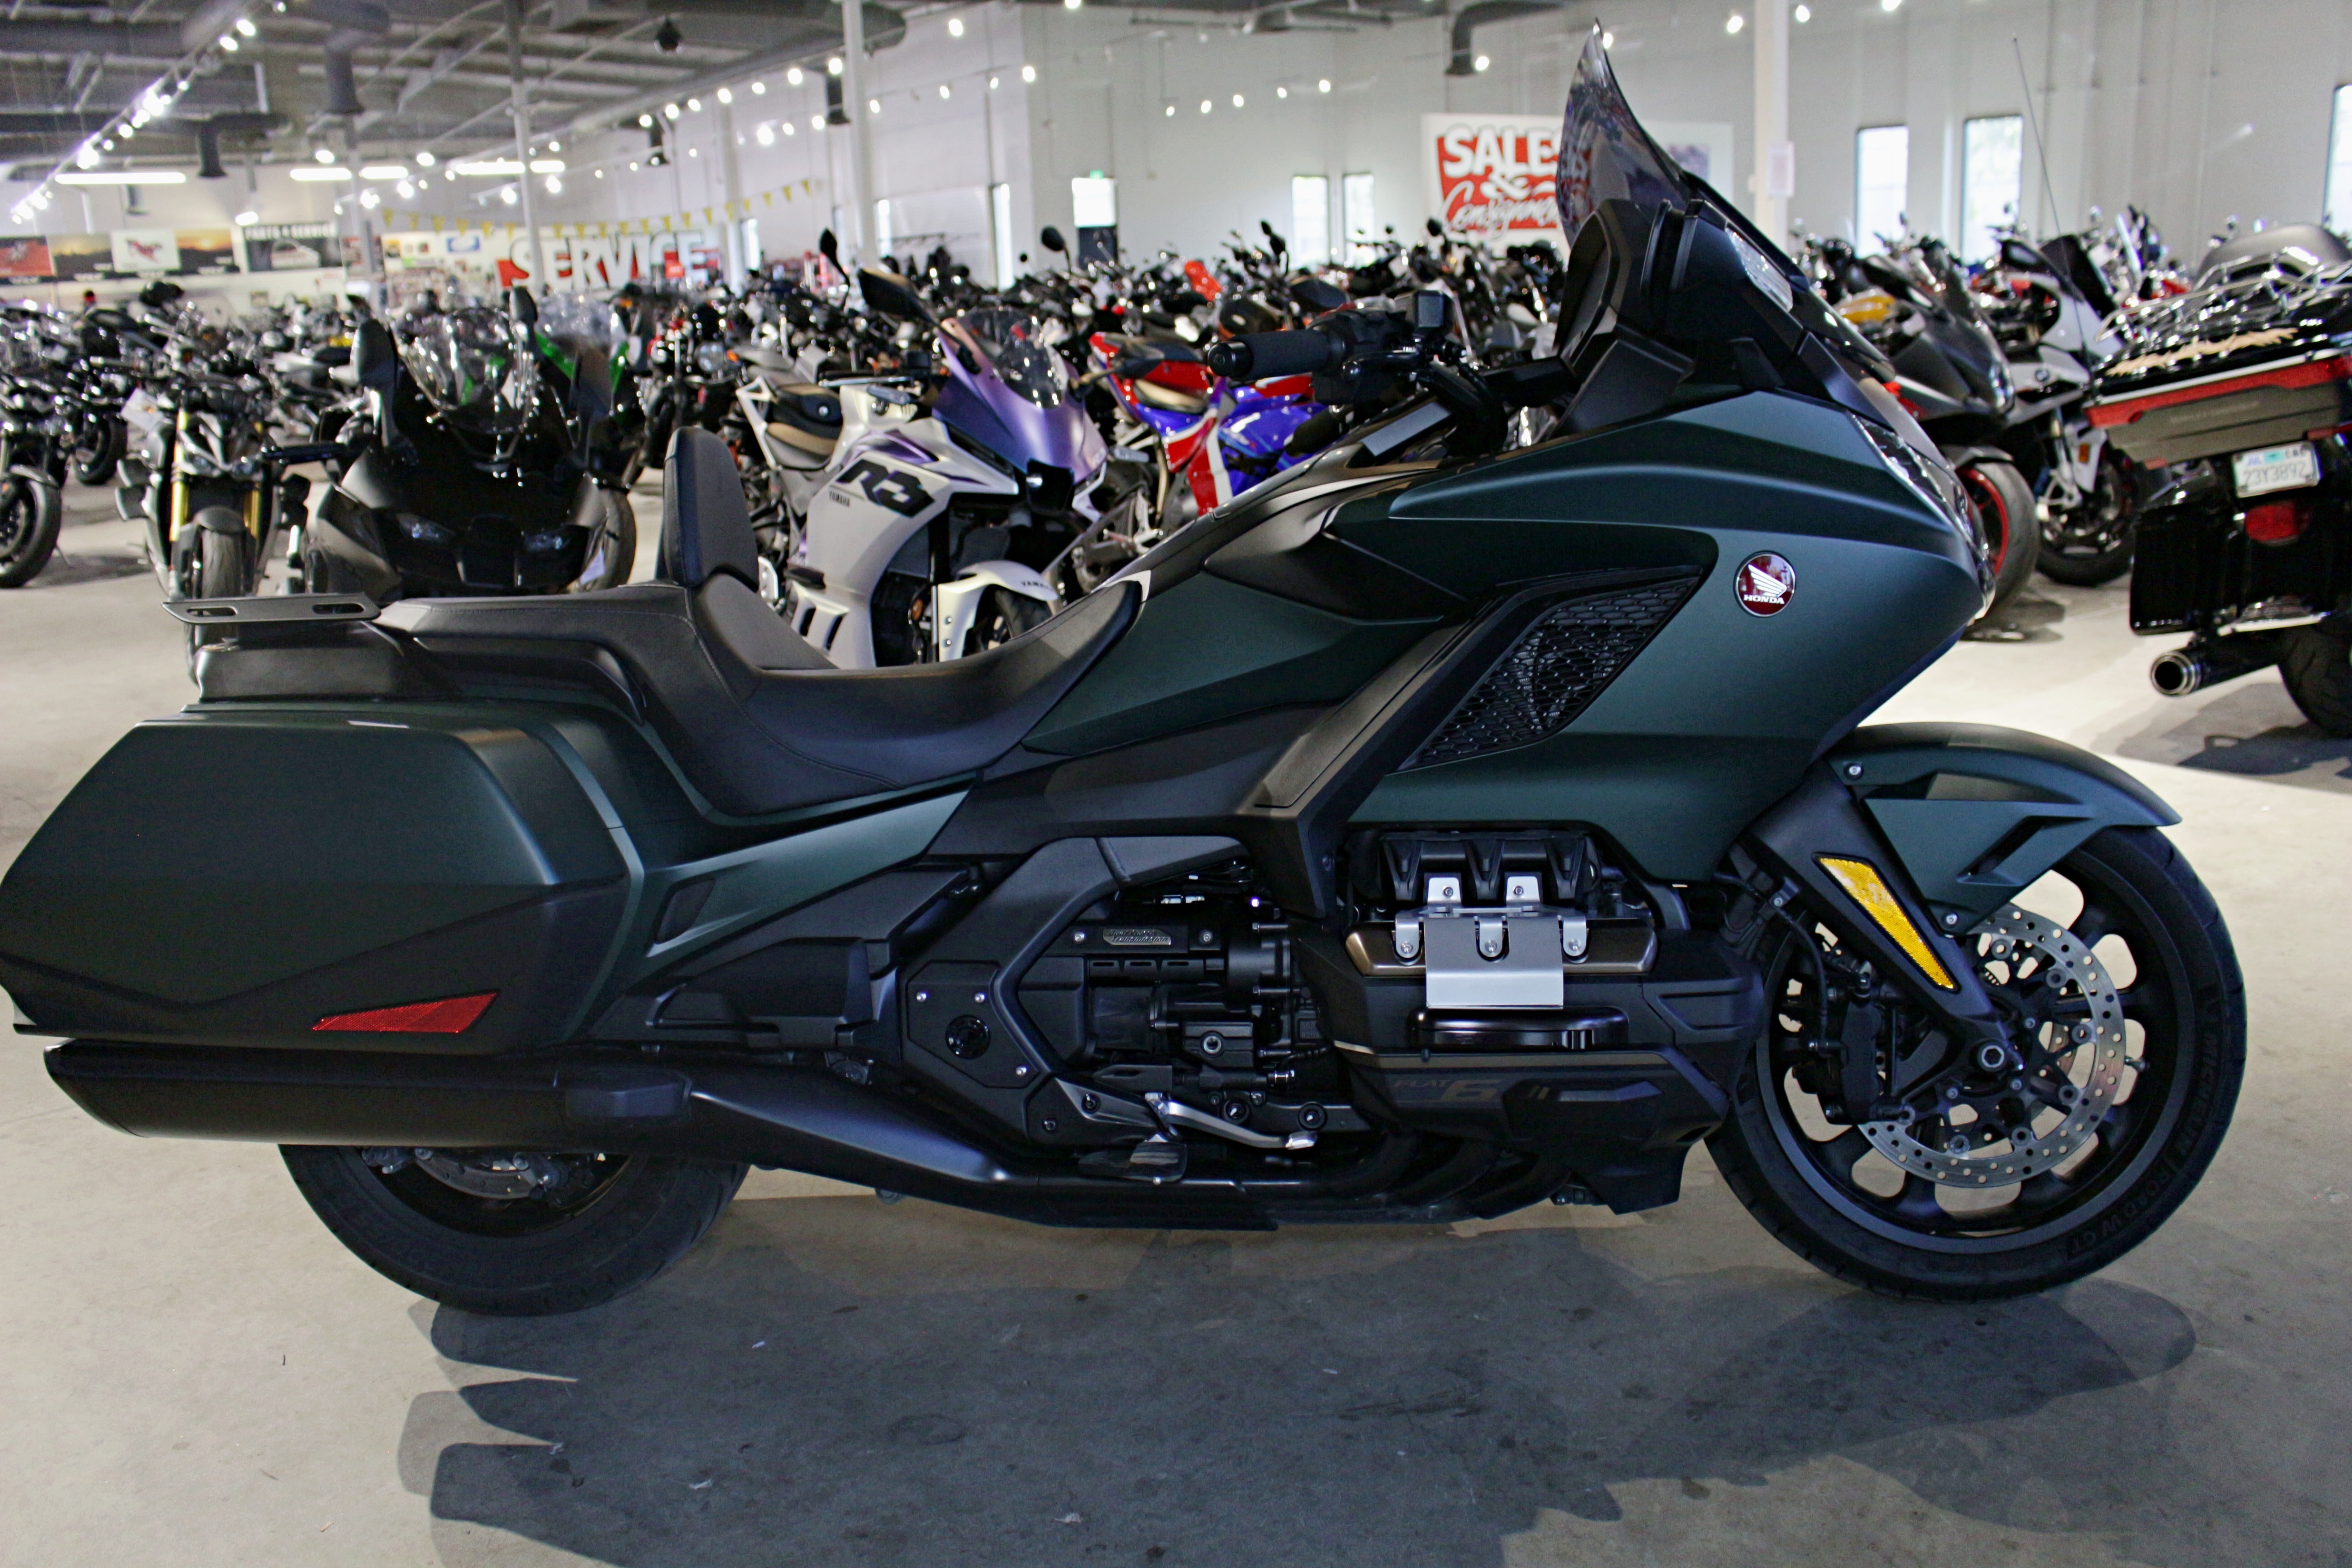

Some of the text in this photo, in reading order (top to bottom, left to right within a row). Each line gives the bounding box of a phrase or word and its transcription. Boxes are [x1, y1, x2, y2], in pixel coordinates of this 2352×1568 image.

[509, 230, 708, 290] SERVICE
[828, 490, 850, 508] YAMAHA
[836, 459, 935, 518] R3
[1743, 594, 1785, 605] HONDA
[1441, 1079, 1502, 1102] 6
